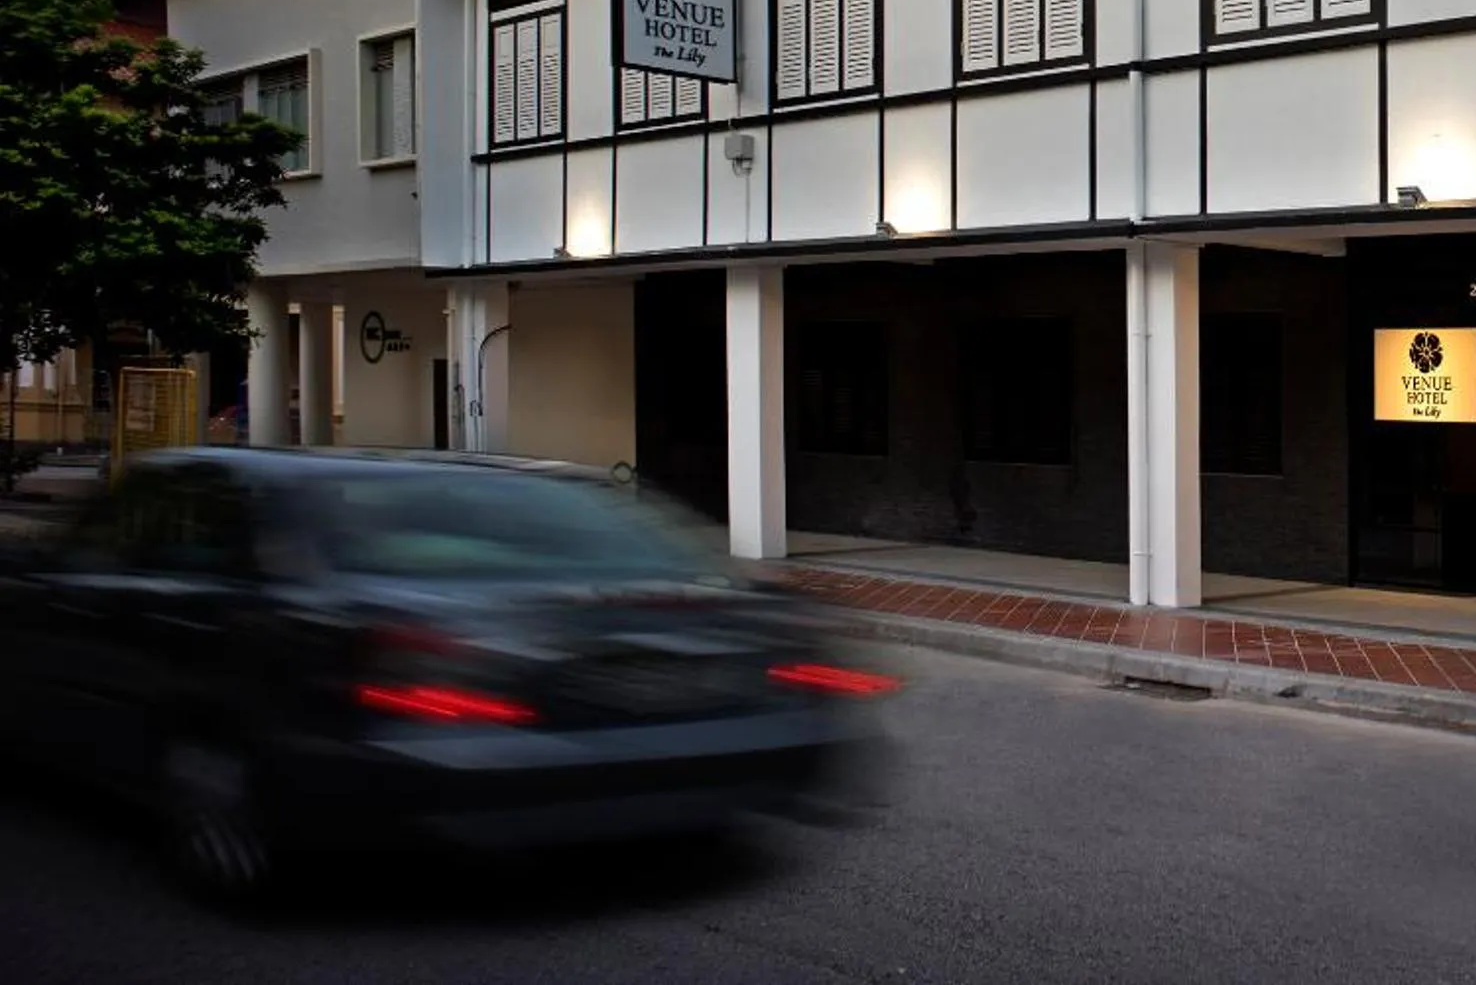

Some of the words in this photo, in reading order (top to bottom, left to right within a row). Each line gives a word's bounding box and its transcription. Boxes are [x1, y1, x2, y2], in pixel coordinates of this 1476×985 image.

[645, 18, 717, 47] HOTEL
[676, 46, 706, 68] Lily
[1401, 376, 1453, 391] VENUE
[1407, 392, 1448, 405] HOTEL
